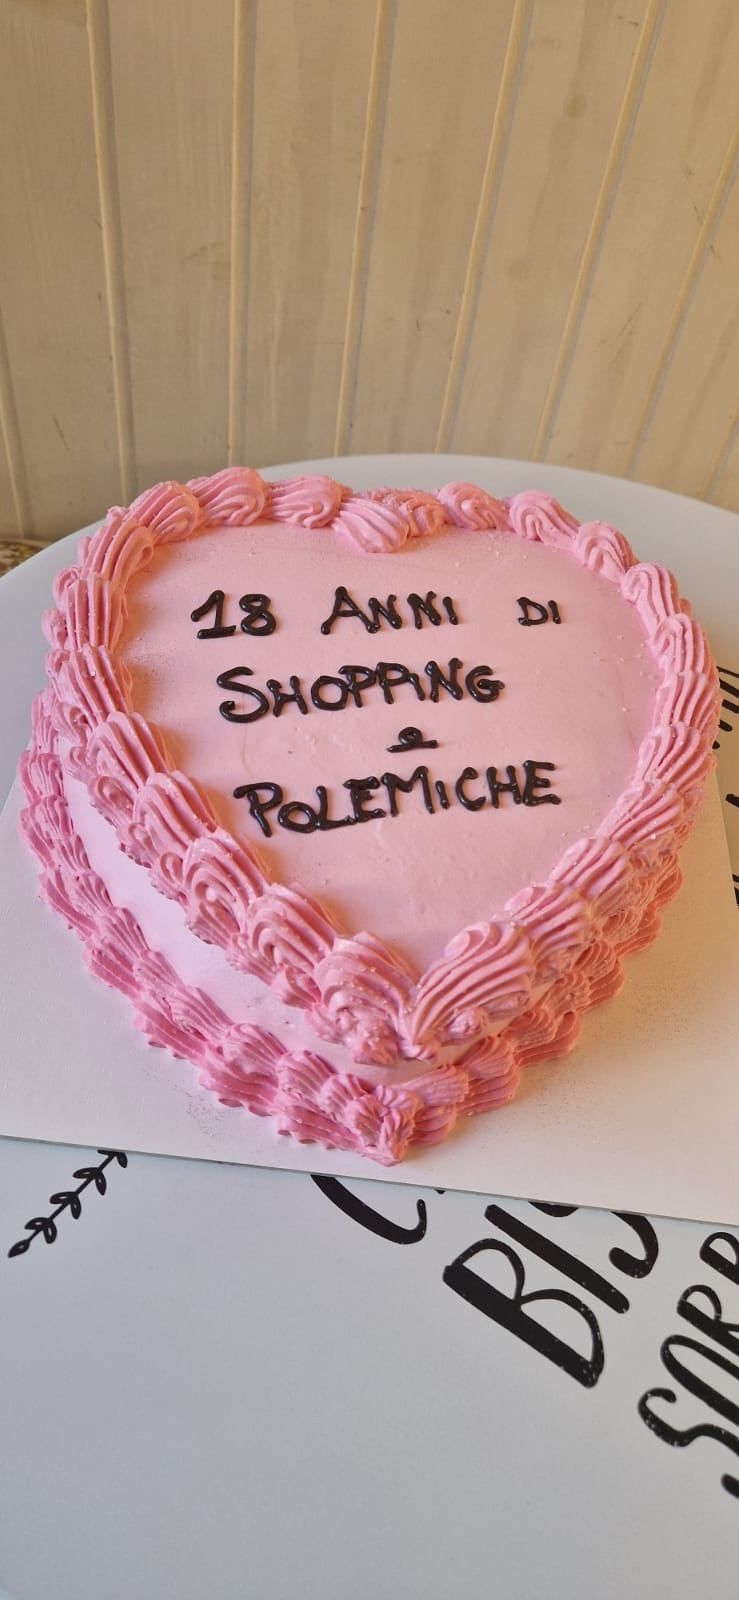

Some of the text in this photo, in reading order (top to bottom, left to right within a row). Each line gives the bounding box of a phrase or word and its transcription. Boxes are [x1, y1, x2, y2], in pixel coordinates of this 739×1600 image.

[190, 586, 562, 640] 18 ANNI DI
